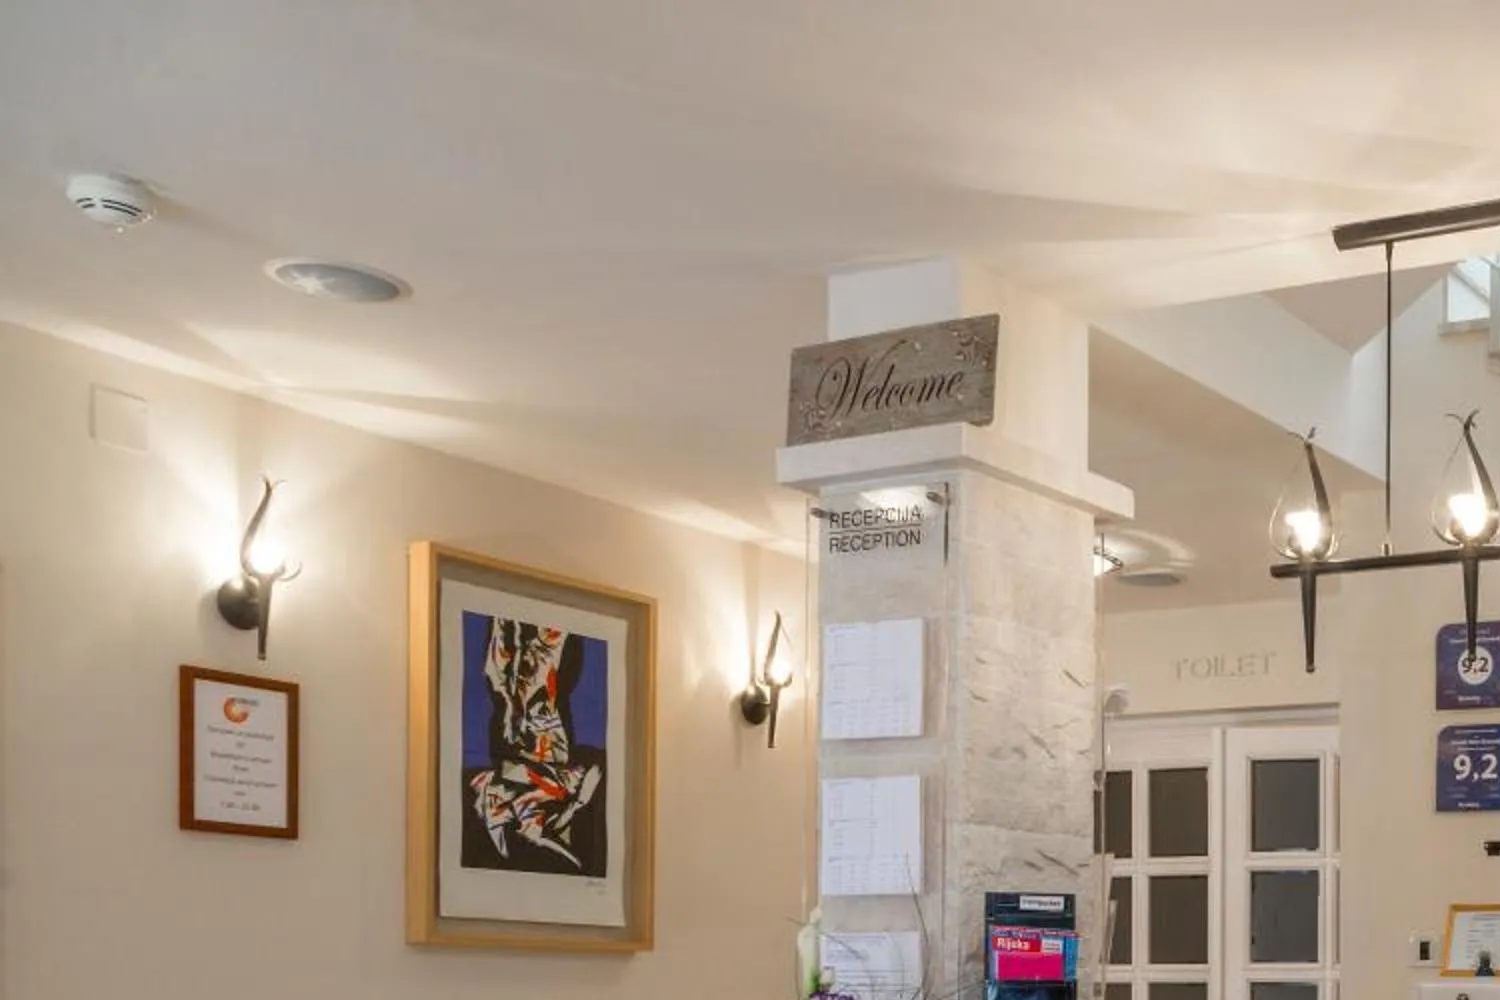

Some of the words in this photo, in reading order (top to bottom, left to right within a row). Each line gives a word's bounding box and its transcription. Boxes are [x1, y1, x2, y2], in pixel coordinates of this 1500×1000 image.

[815, 338, 966, 421] Welcome
[829, 528, 922, 554] RECEPTION
[1171, 651, 1277, 680] TOILET
[1453, 753, 1498, 782] 9,2
